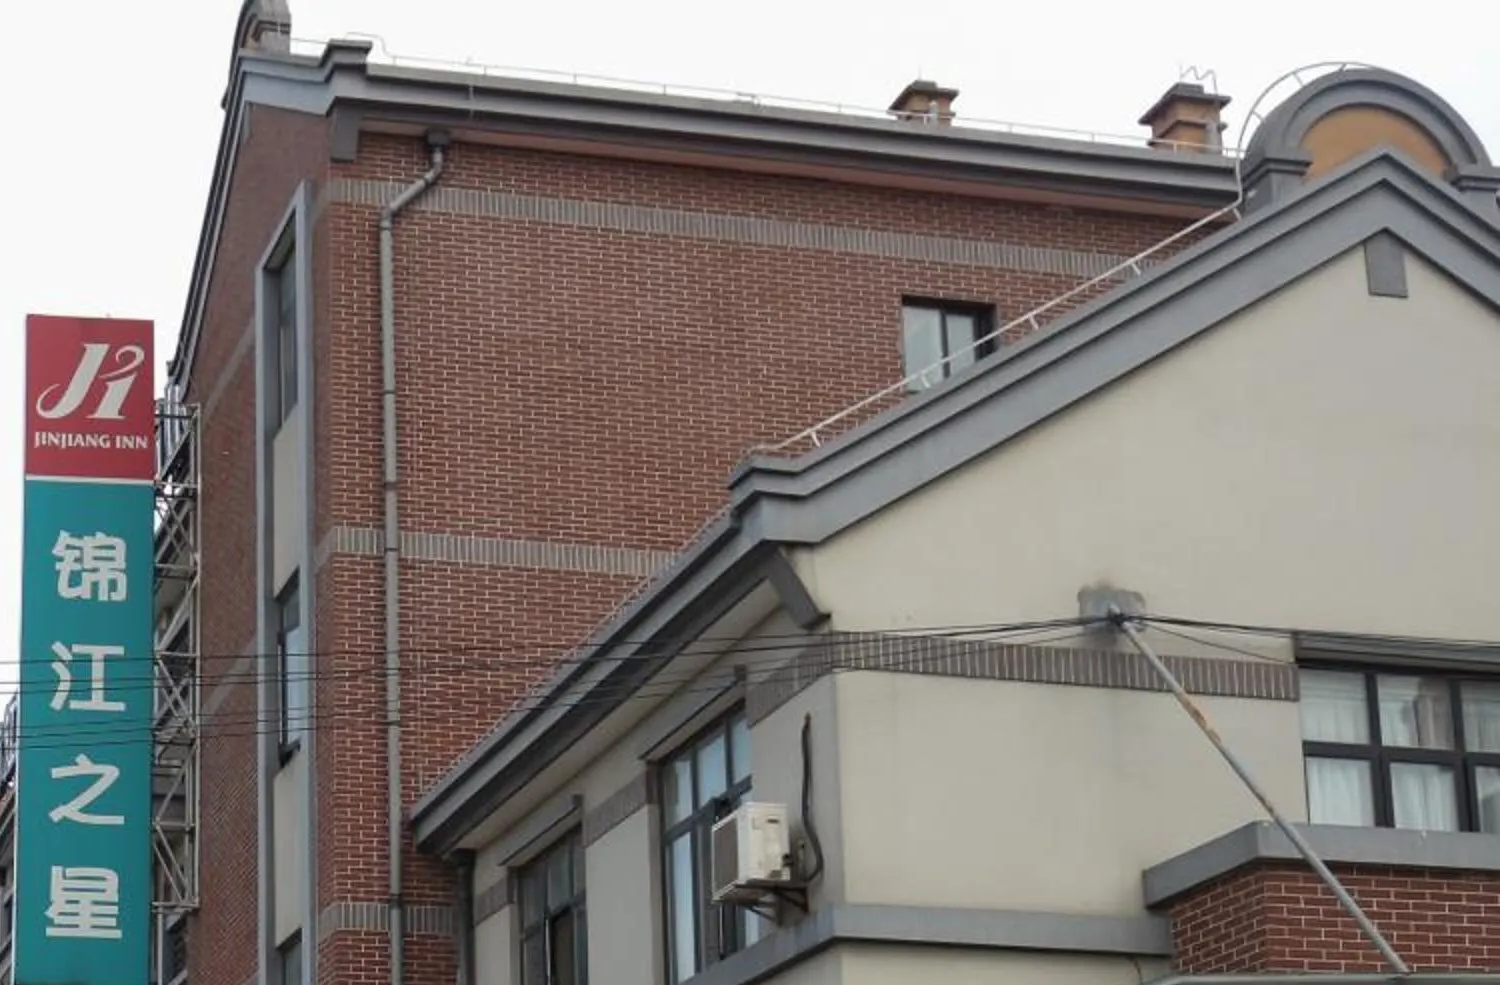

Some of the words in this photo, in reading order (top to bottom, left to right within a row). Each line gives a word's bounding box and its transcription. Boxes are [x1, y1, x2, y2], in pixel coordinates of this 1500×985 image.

[34, 431, 111, 449] JINJIANG
[115, 434, 149, 449] INN
[46, 530, 128, 939] 锦江之星
